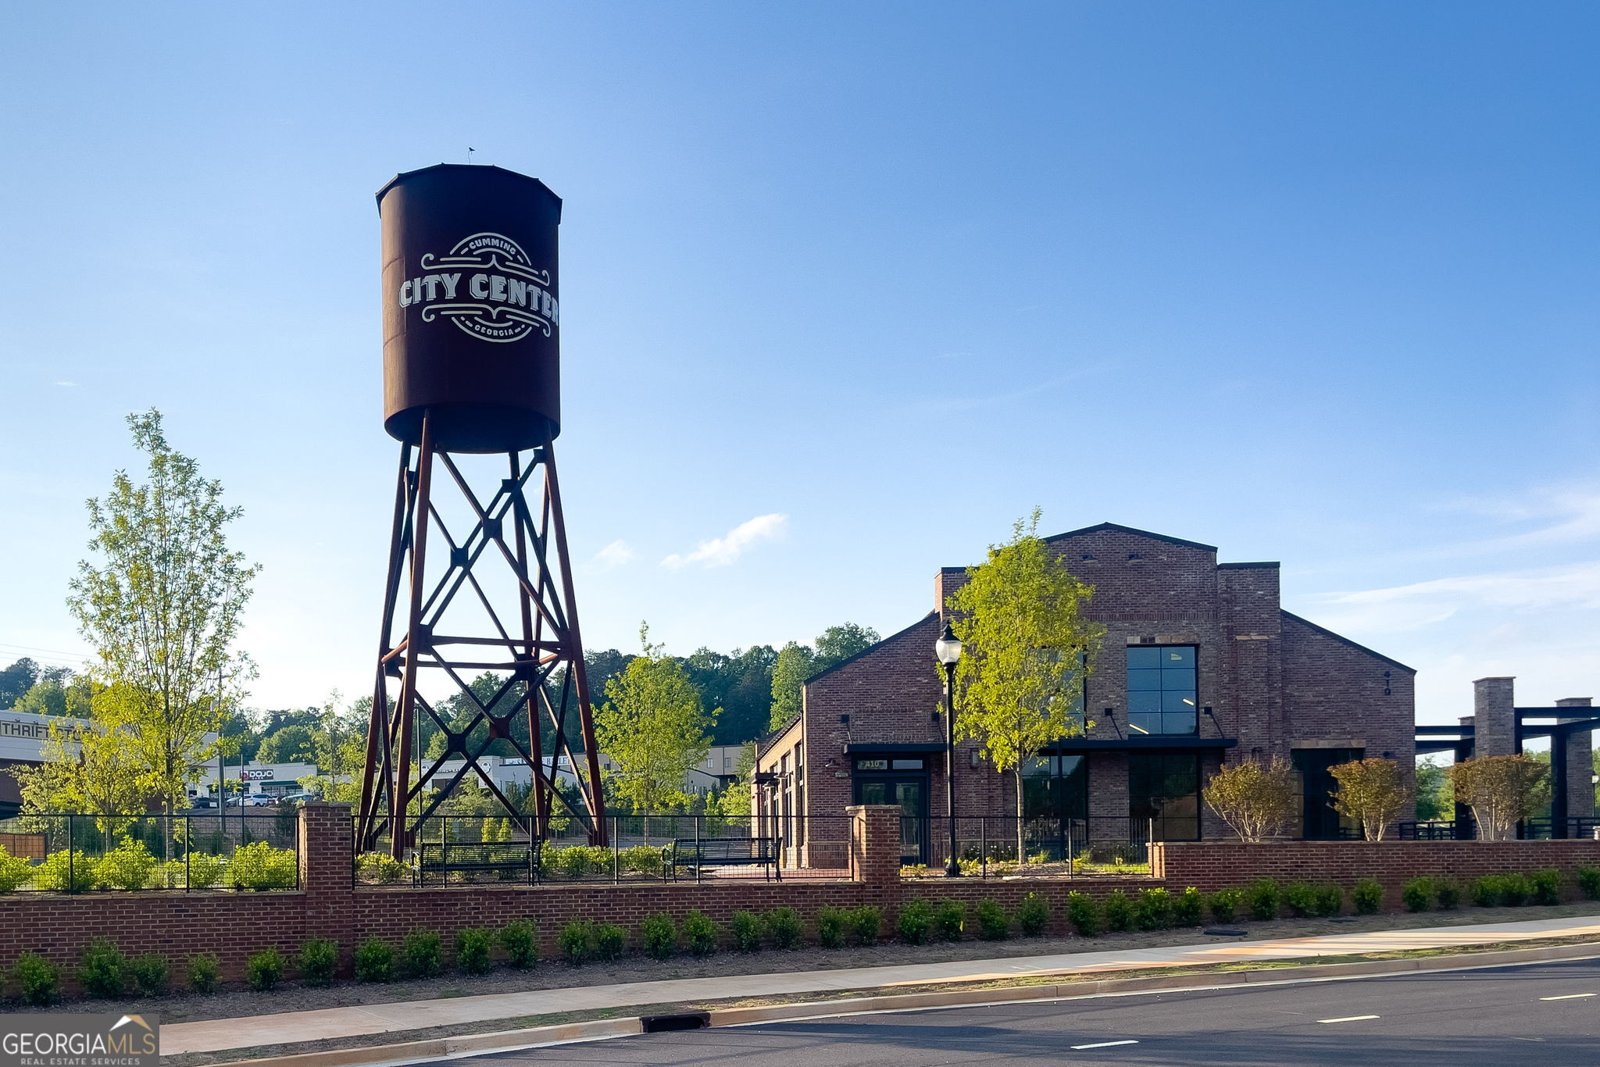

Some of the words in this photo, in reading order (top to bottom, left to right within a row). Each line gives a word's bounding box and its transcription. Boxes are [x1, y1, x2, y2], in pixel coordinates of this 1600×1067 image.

[468, 237, 516, 255] CUMMING
[399, 272, 462, 308] CITY
[469, 273, 559, 326] CENTER
[474, 324, 514, 337] GEORGIA
